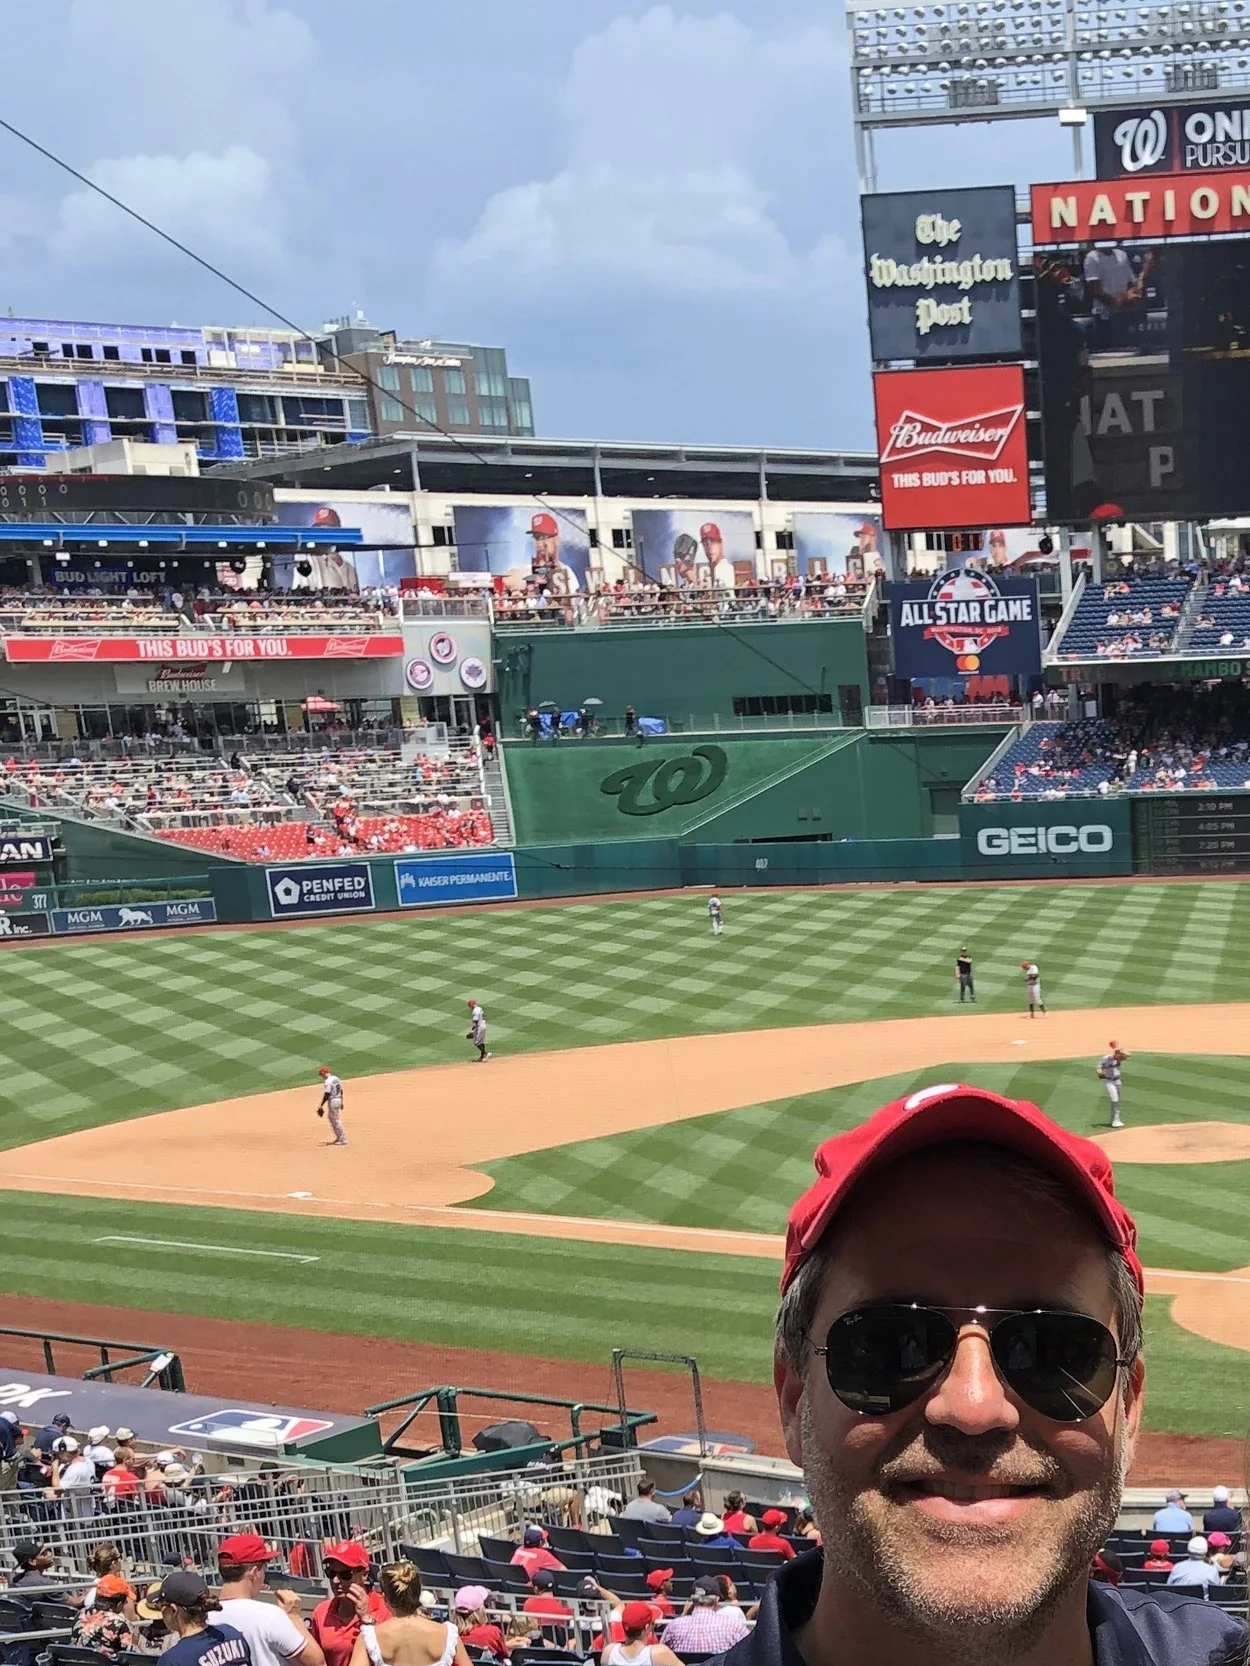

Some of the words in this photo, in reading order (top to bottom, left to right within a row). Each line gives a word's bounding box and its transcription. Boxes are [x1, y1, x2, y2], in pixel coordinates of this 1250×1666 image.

[914, 213, 962, 247] The
[869, 253, 1014, 289] Washington
[915, 296, 974, 334] Post
[889, 418, 1008, 449] Budweiser
[892, 472, 919, 489] THIS
[921, 470, 959, 487] BUD'S
[961, 469, 986, 485] FOR
[988, 468, 1018, 484] YOU.
[55, 571, 86, 583] BUD
[133, 571, 166, 584] LOFT
[984, 599, 1032, 623] GAME
[53, 643, 96, 656] Budweiser
[136, 639, 174, 657] THIS
[177, 639, 223, 657] BUD'S
[225, 639, 256, 656] FOR
[258, 639, 292, 656] YOU.
[977, 825, 1113, 855] GEICO
[302, 877, 365, 893] PENFED
[418, 876, 449, 888] KAISER
[304, 893, 334, 901] CREDIT
[337, 891, 365, 900] UNION
[67, 911, 103, 924] MGM
[166, 904, 200, 916] MGM
